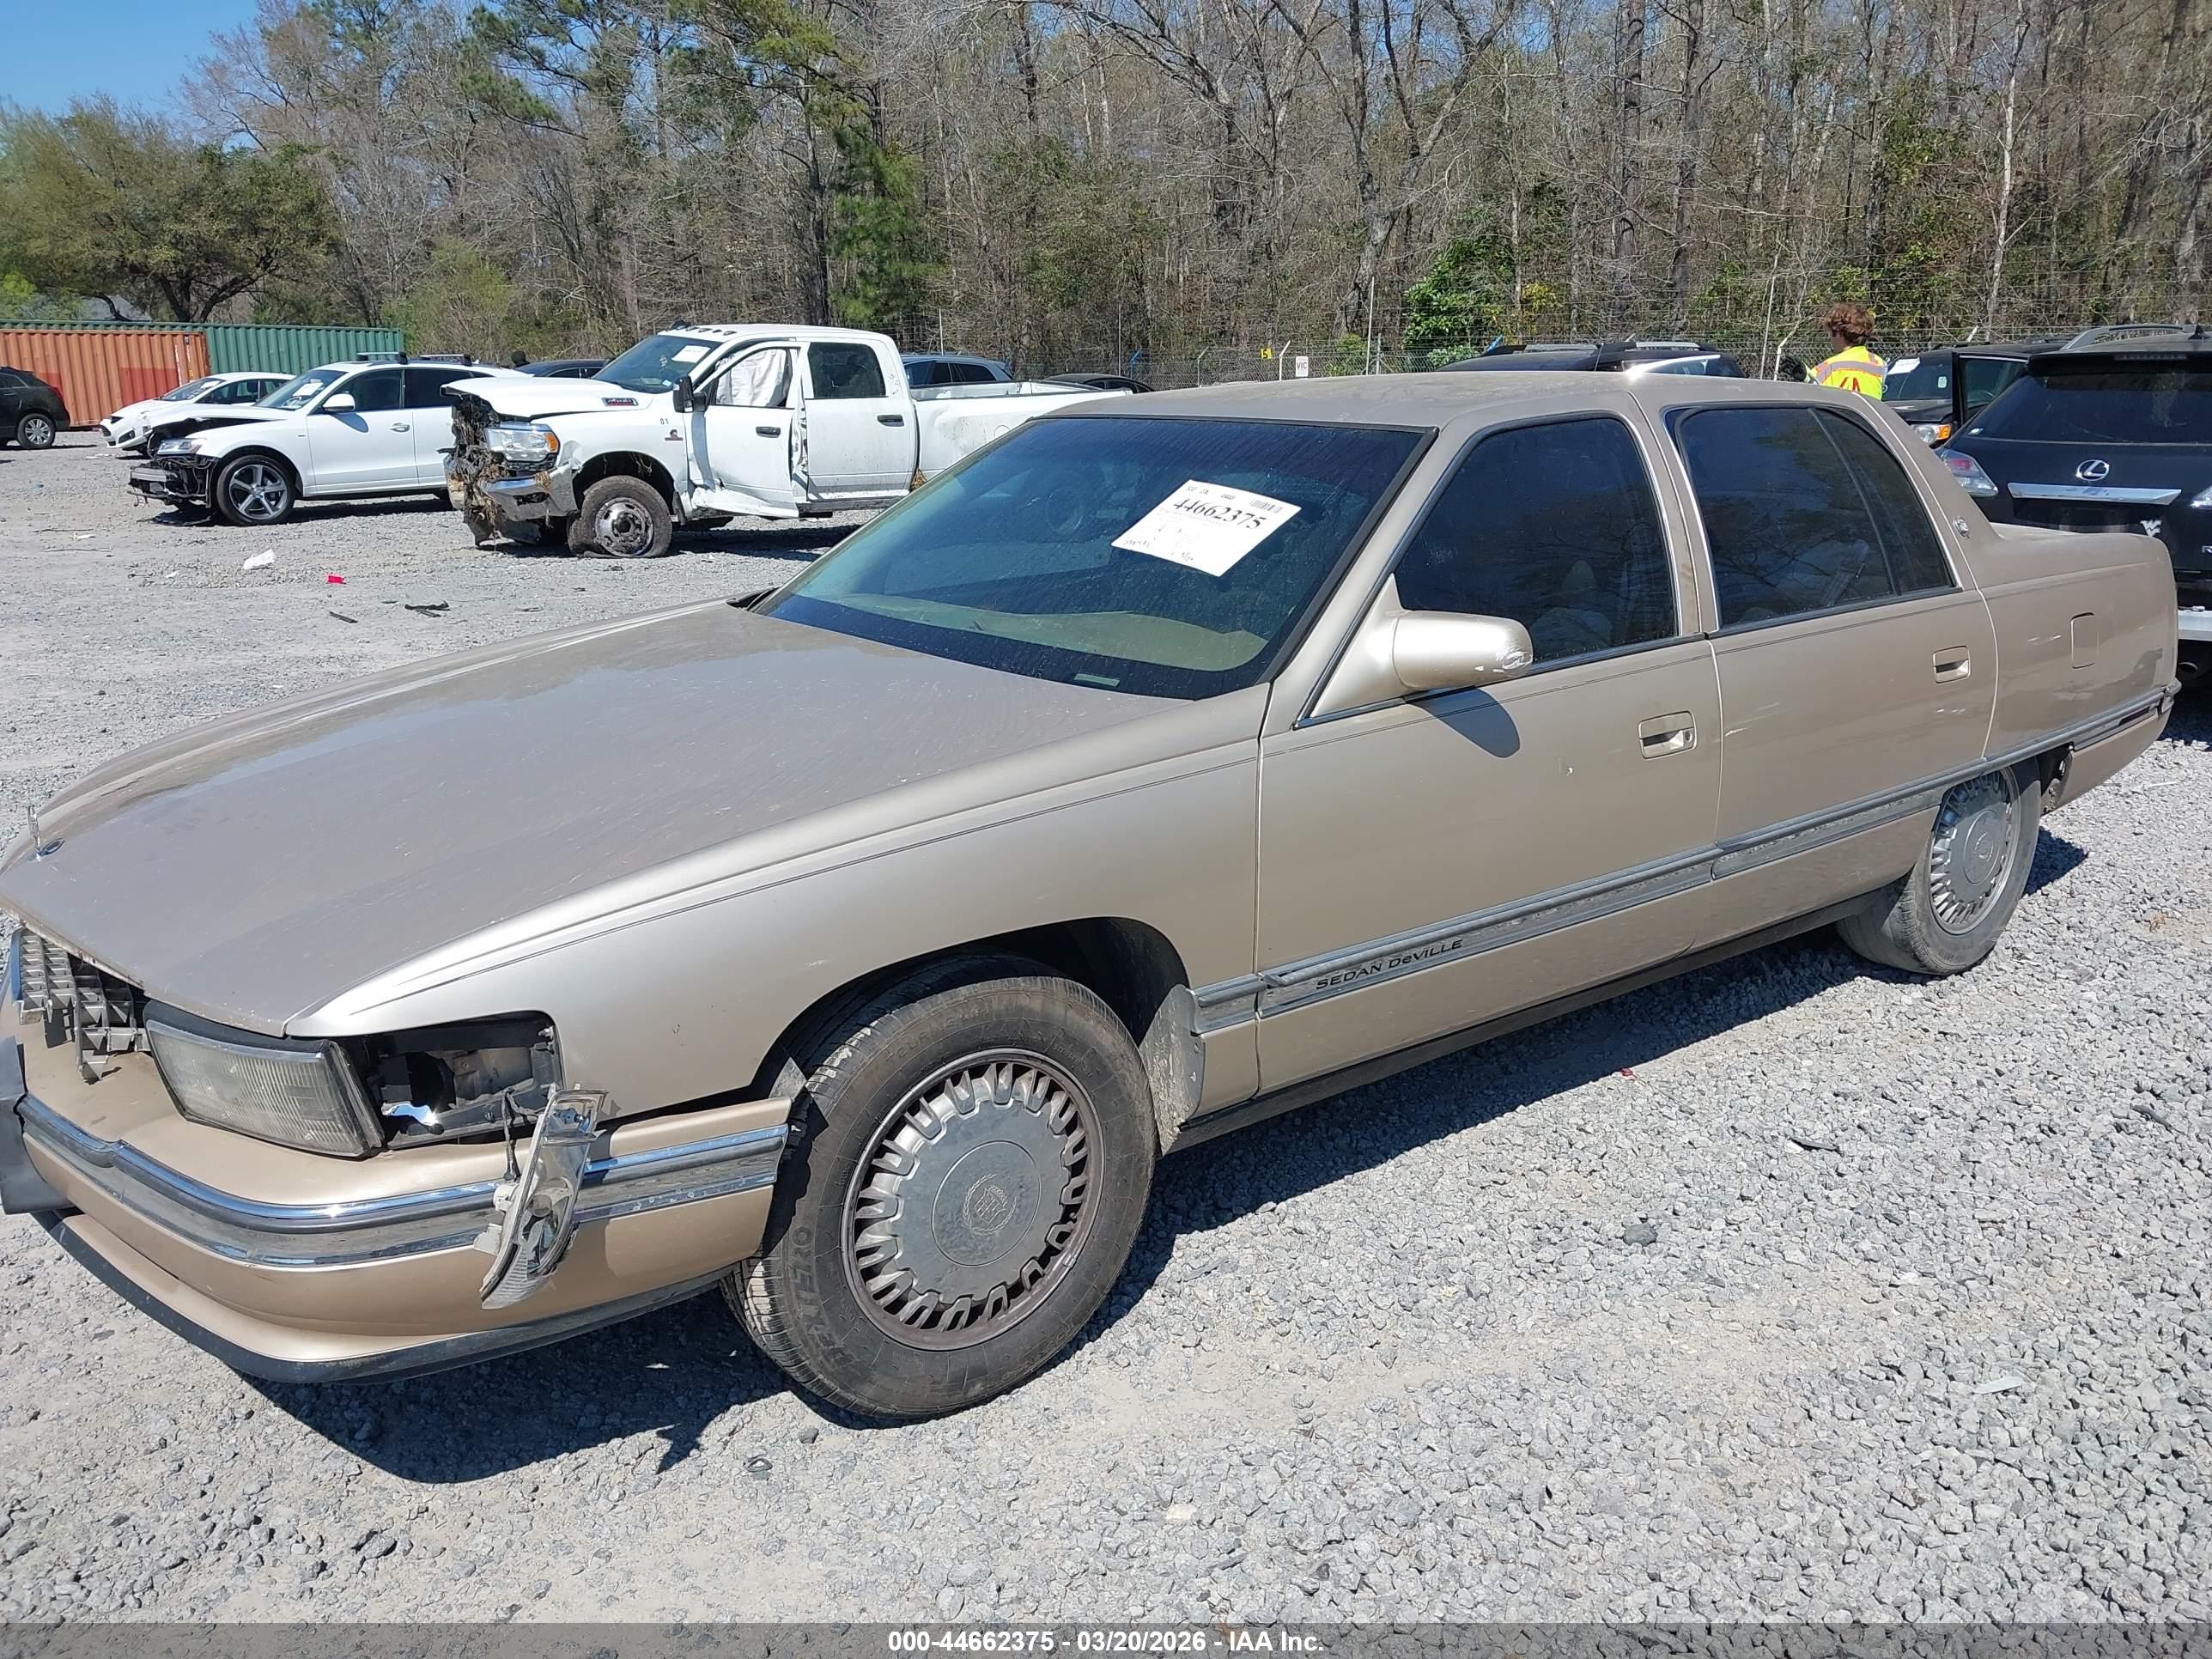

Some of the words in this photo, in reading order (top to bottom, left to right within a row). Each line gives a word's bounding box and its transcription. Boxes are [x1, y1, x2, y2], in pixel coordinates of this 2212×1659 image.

[1173, 497, 1267, 530] 44662375
[1316, 963, 1382, 990] SEDAN
[1388, 939, 1463, 969] DeVILLE
